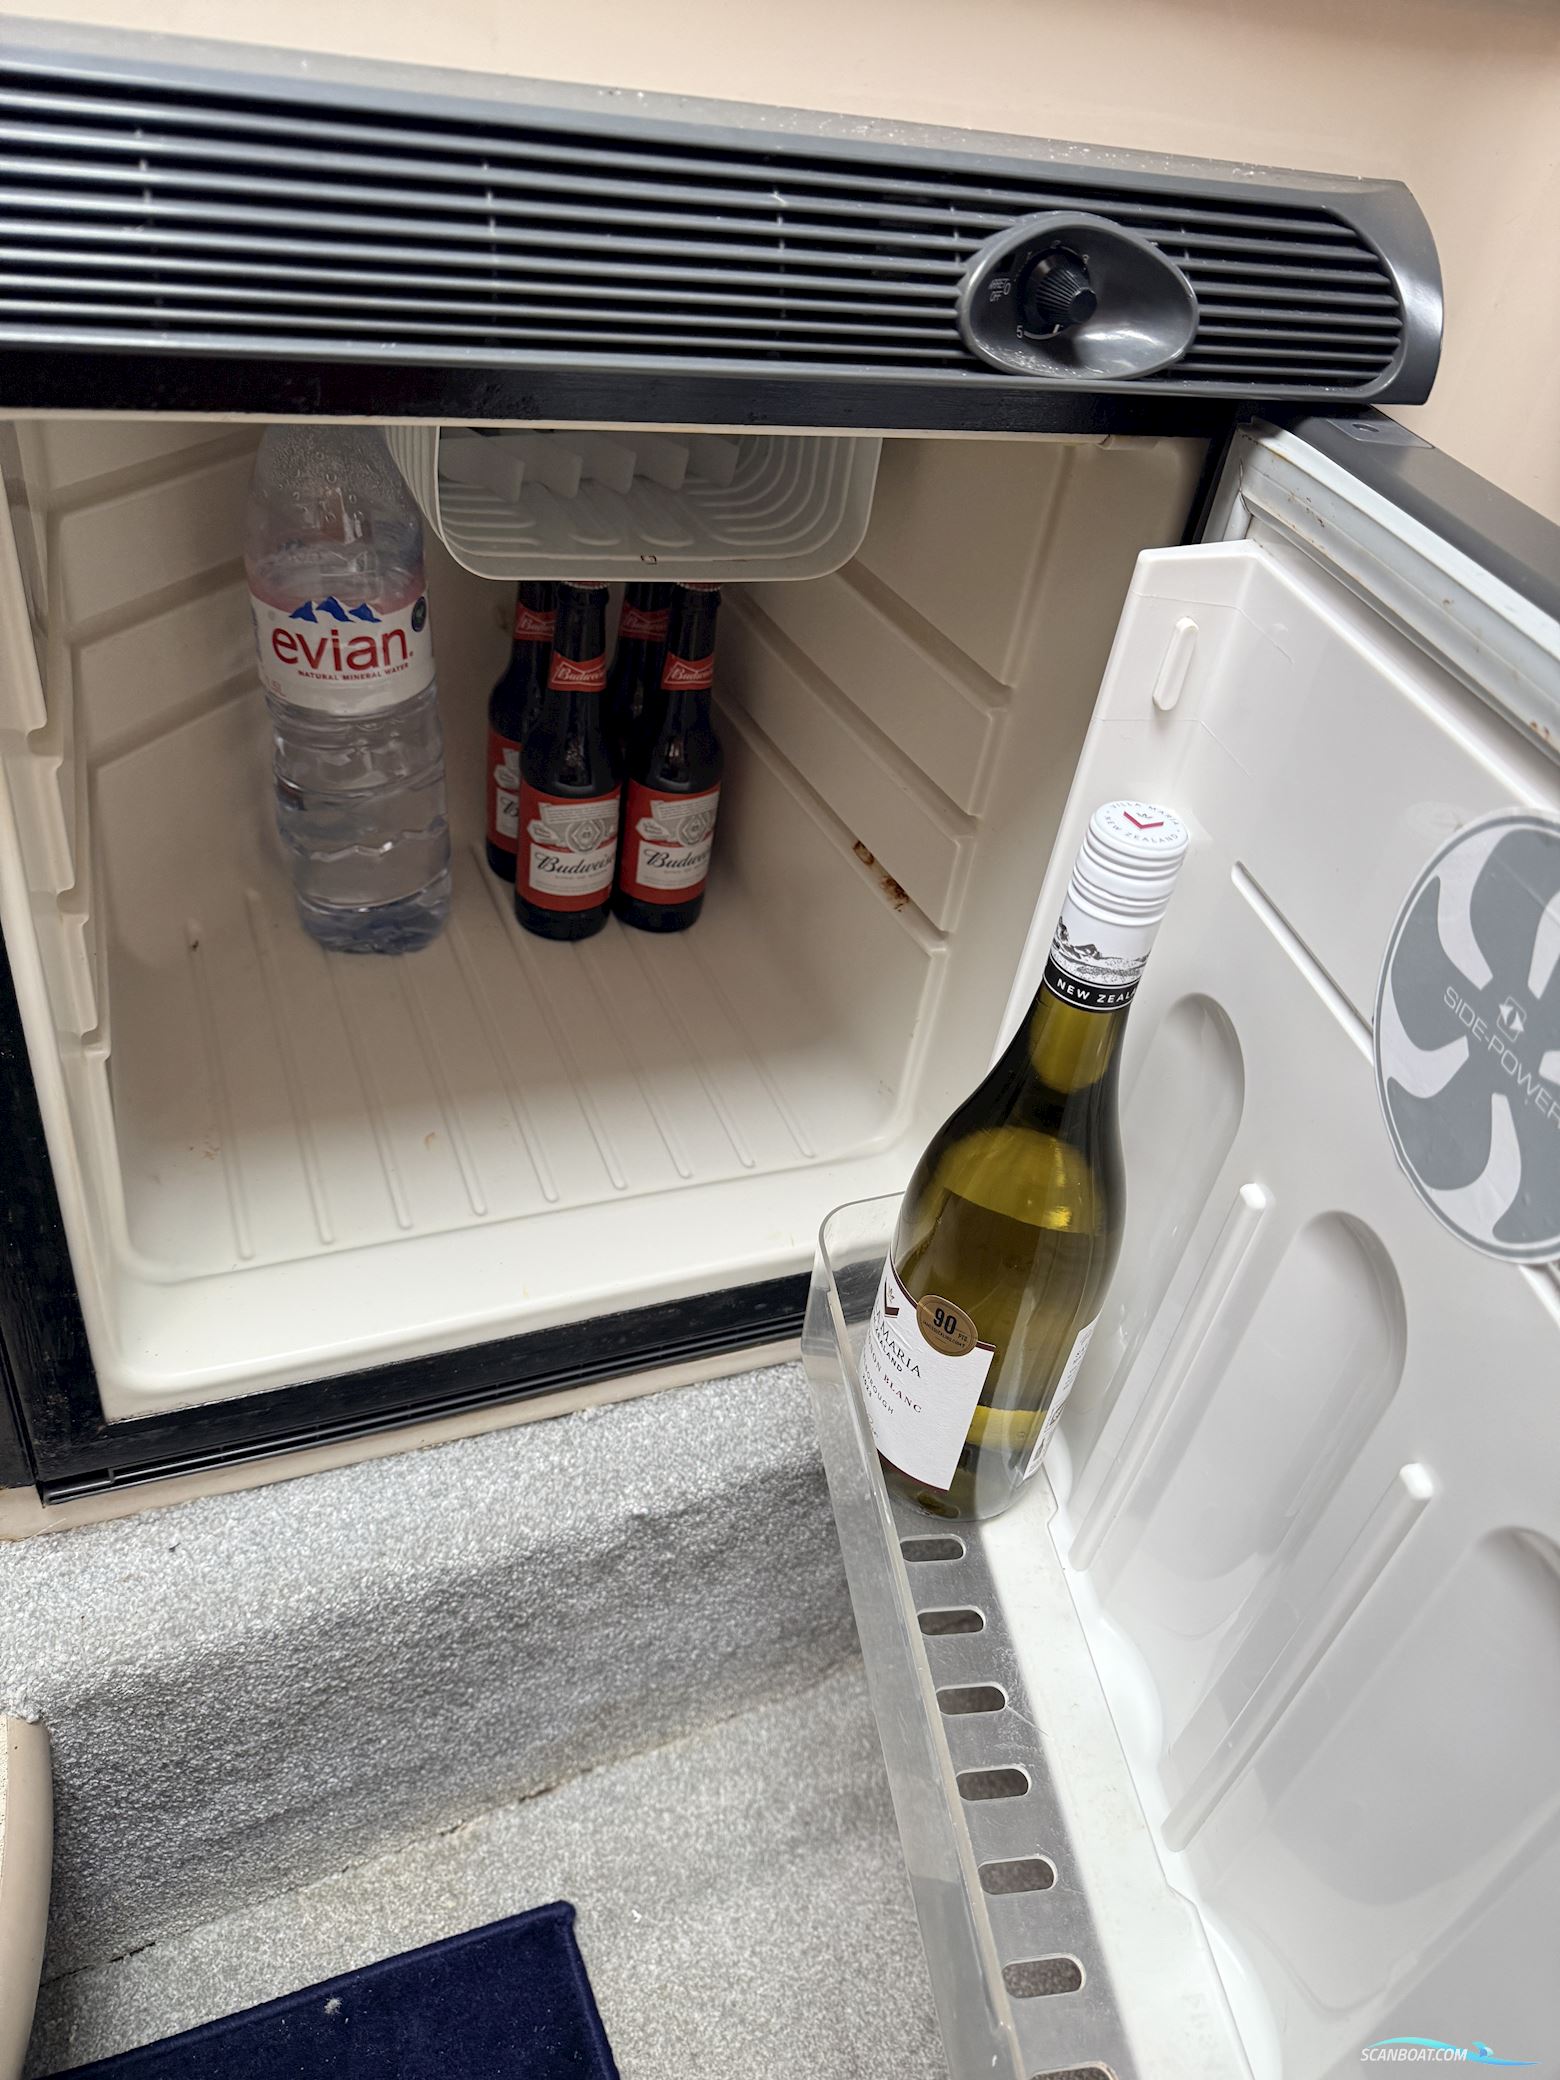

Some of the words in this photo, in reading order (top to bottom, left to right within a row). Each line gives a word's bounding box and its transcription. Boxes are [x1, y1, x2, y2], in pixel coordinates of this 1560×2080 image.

[1016, 325, 1024, 338] 5
[271, 627, 408, 671] evian
[297, 670, 338, 681] NATURAL
[342, 670, 382, 681] MINERAL
[384, 662, 409, 675] WATER
[1057, 978, 1091, 1000] NEW
[933, 1307, 957, 1335] 90
[880, 1319, 921, 1378] MARIA
[883, 1373, 922, 1414] BLANC
